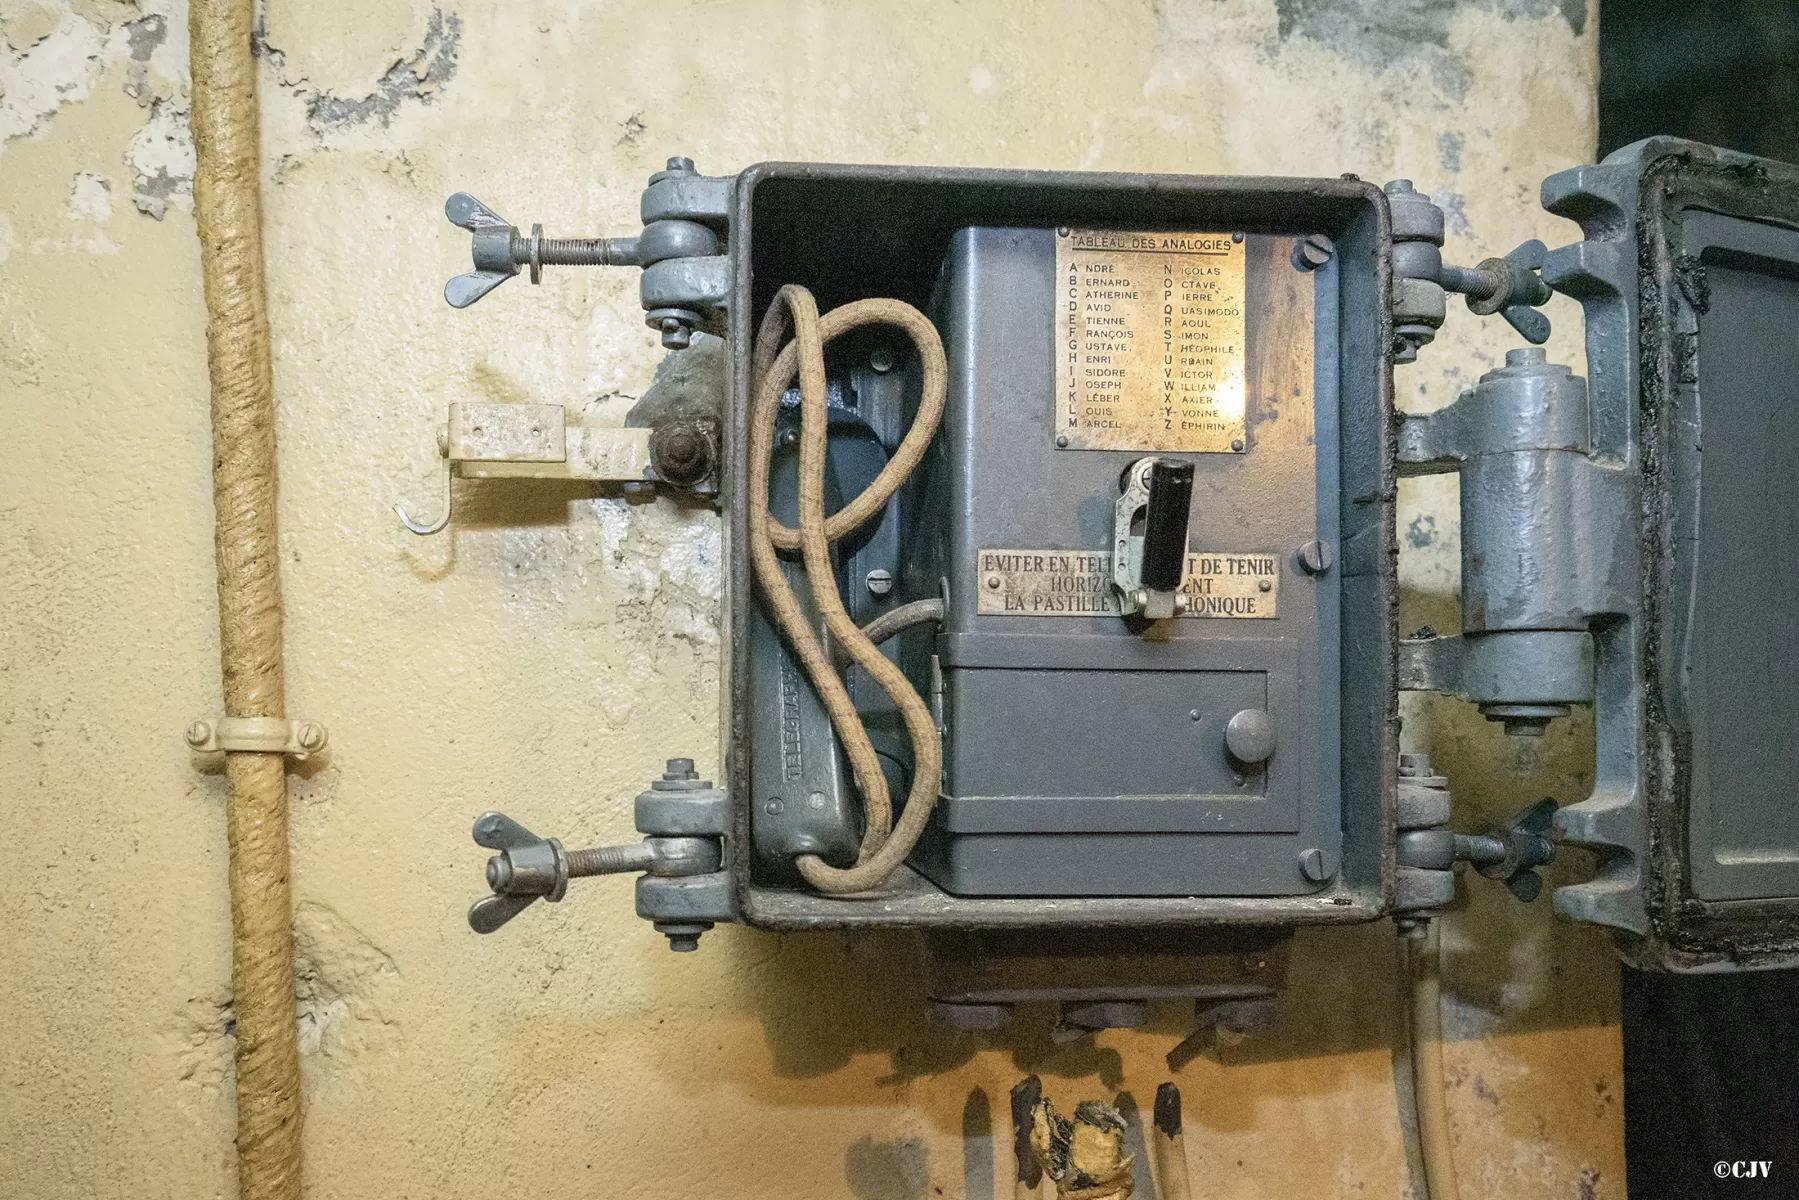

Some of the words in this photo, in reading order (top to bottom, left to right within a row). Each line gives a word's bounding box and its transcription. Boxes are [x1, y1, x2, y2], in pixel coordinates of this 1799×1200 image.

[1071, 236, 1124, 248] TABLEAU
[1132, 238, 1156, 249] DES
[1162, 239, 1232, 250] ANALOGIES
[1069, 262, 1078, 272] A
[1086, 264, 1115, 273] NDRÉ
[1164, 264, 1172, 274] N
[1069, 276, 1077, 286] B
[1086, 278, 1130, 287] ERNARD
[1164, 278, 1172, 288] O
[1182, 280, 1216, 289] CTAVE
[1069, 288, 1078, 298] C
[1086, 291, 1139, 300] ATHERINE
[1164, 290, 1172, 300] P
[1182, 294, 1212, 302] IERRE
[1069, 302, 1077, 311] D
[1086, 304, 1112, 312] AVID
[1164, 304, 1172, 316] Q
[1182, 308, 1240, 316] UASIMODO
[1069, 314, 1076, 324] E
[1086, 317, 1126, 325] TIENNE
[1164, 317, 1172, 326] R
[1182, 320, 1211, 328] AOUL
[1069, 328, 1076, 337] F
[1086, 330, 1134, 340] RANÇOIS
[1164, 330, 1172, 340] S
[1182, 332, 1209, 340] IMON
[1068, 340, 1078, 350] G
[1164, 342, 1172, 352] T
[1069, 352, 1076, 362] H
[1086, 356, 1111, 364] ENRI
[1164, 355, 1172, 364] U
[1181, 358, 1213, 366] RBAIN
[1070, 366, 1072, 376] I
[1086, 368, 1126, 376] SIDORE
[1164, 368, 1172, 378] V
[1069, 378, 1076, 388] J
[1086, 381, 1122, 389] OSEPH
[1164, 381, 1174, 390] W
[1181, 384, 1216, 392] ILLIAM
[1069, 392, 1076, 402] K
[1086, 394, 1120, 402] LÉBER
[1164, 393, 1171, 404] X
[1182, 396, 1213, 404] AXIER
[1069, 404, 1076, 414] L
[1086, 408, 1112, 416] OUIS
[1164, 406, 1172, 416] Y
[1182, 410, 1219, 418] VONNE
[1069, 418, 1078, 428] M
[1086, 420, 1122, 428] ARCEL
[1164, 420, 1172, 430] Z
[1048, 556, 1070, 572] EN
[1201, 558, 1222, 575] DE
[1226, 558, 1274, 575] TENIR
[1004, 595, 1025, 611] LA
[1034, 595, 1110, 612] PASTILLE
